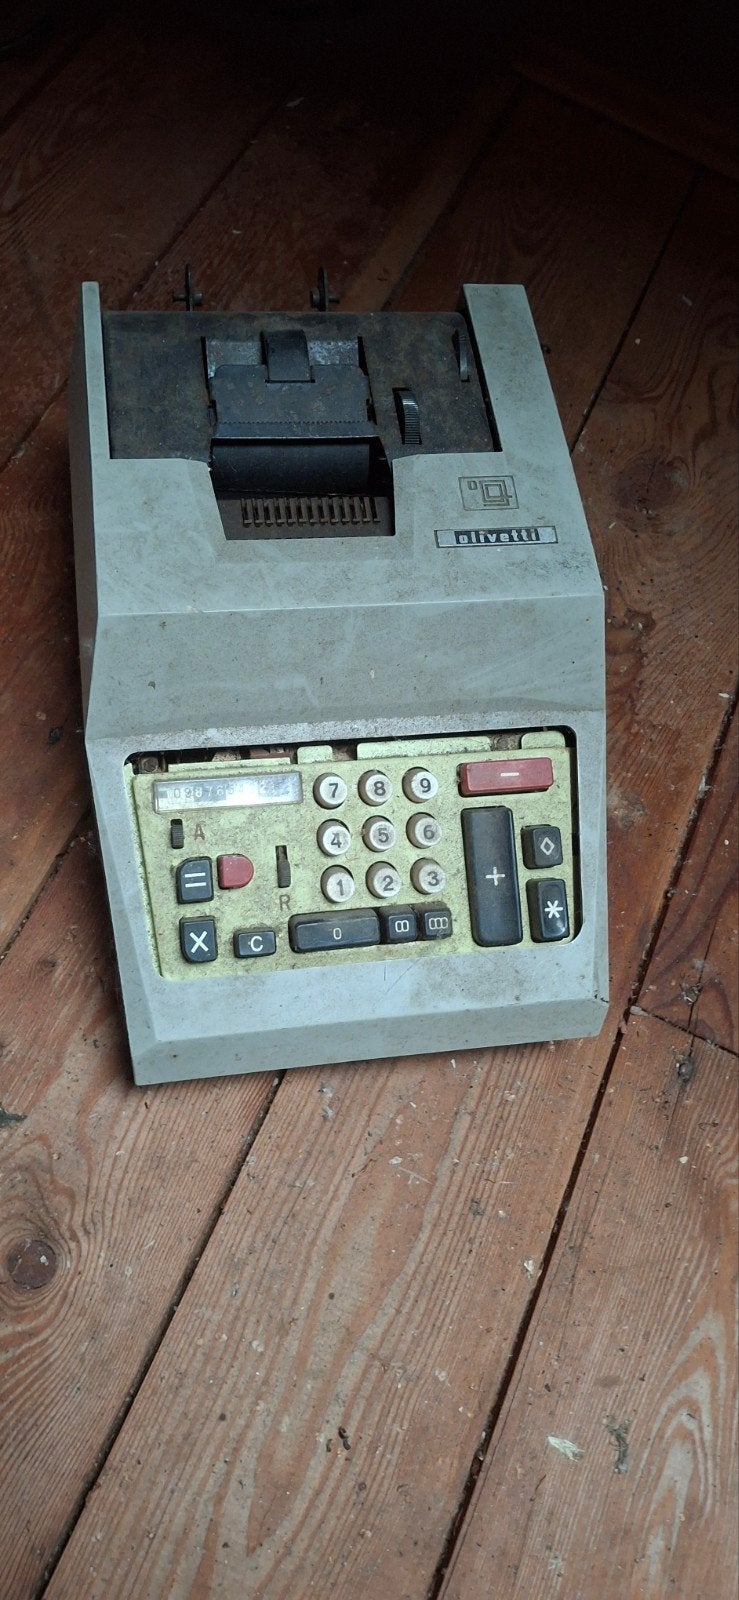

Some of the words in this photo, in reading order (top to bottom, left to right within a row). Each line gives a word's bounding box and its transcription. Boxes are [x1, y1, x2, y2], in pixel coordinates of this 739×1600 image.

[458, 529, 537, 544] olivetti
[329, 783, 339, 798] 7
[373, 781, 386, 796] 8
[419, 778, 432, 793] 9
[194, 824, 206, 841] A
[330, 833, 342, 848] 4
[377, 827, 389, 843] 5
[423, 824, 435, 840] 6
[336, 879, 345, 896] 1
[382, 875, 394, 891] 2
[427, 871, 440, 886] 3
[278, 895, 291, 911] R
[333, 927, 342, 940] 0
[250, 935, 264, 952] C
